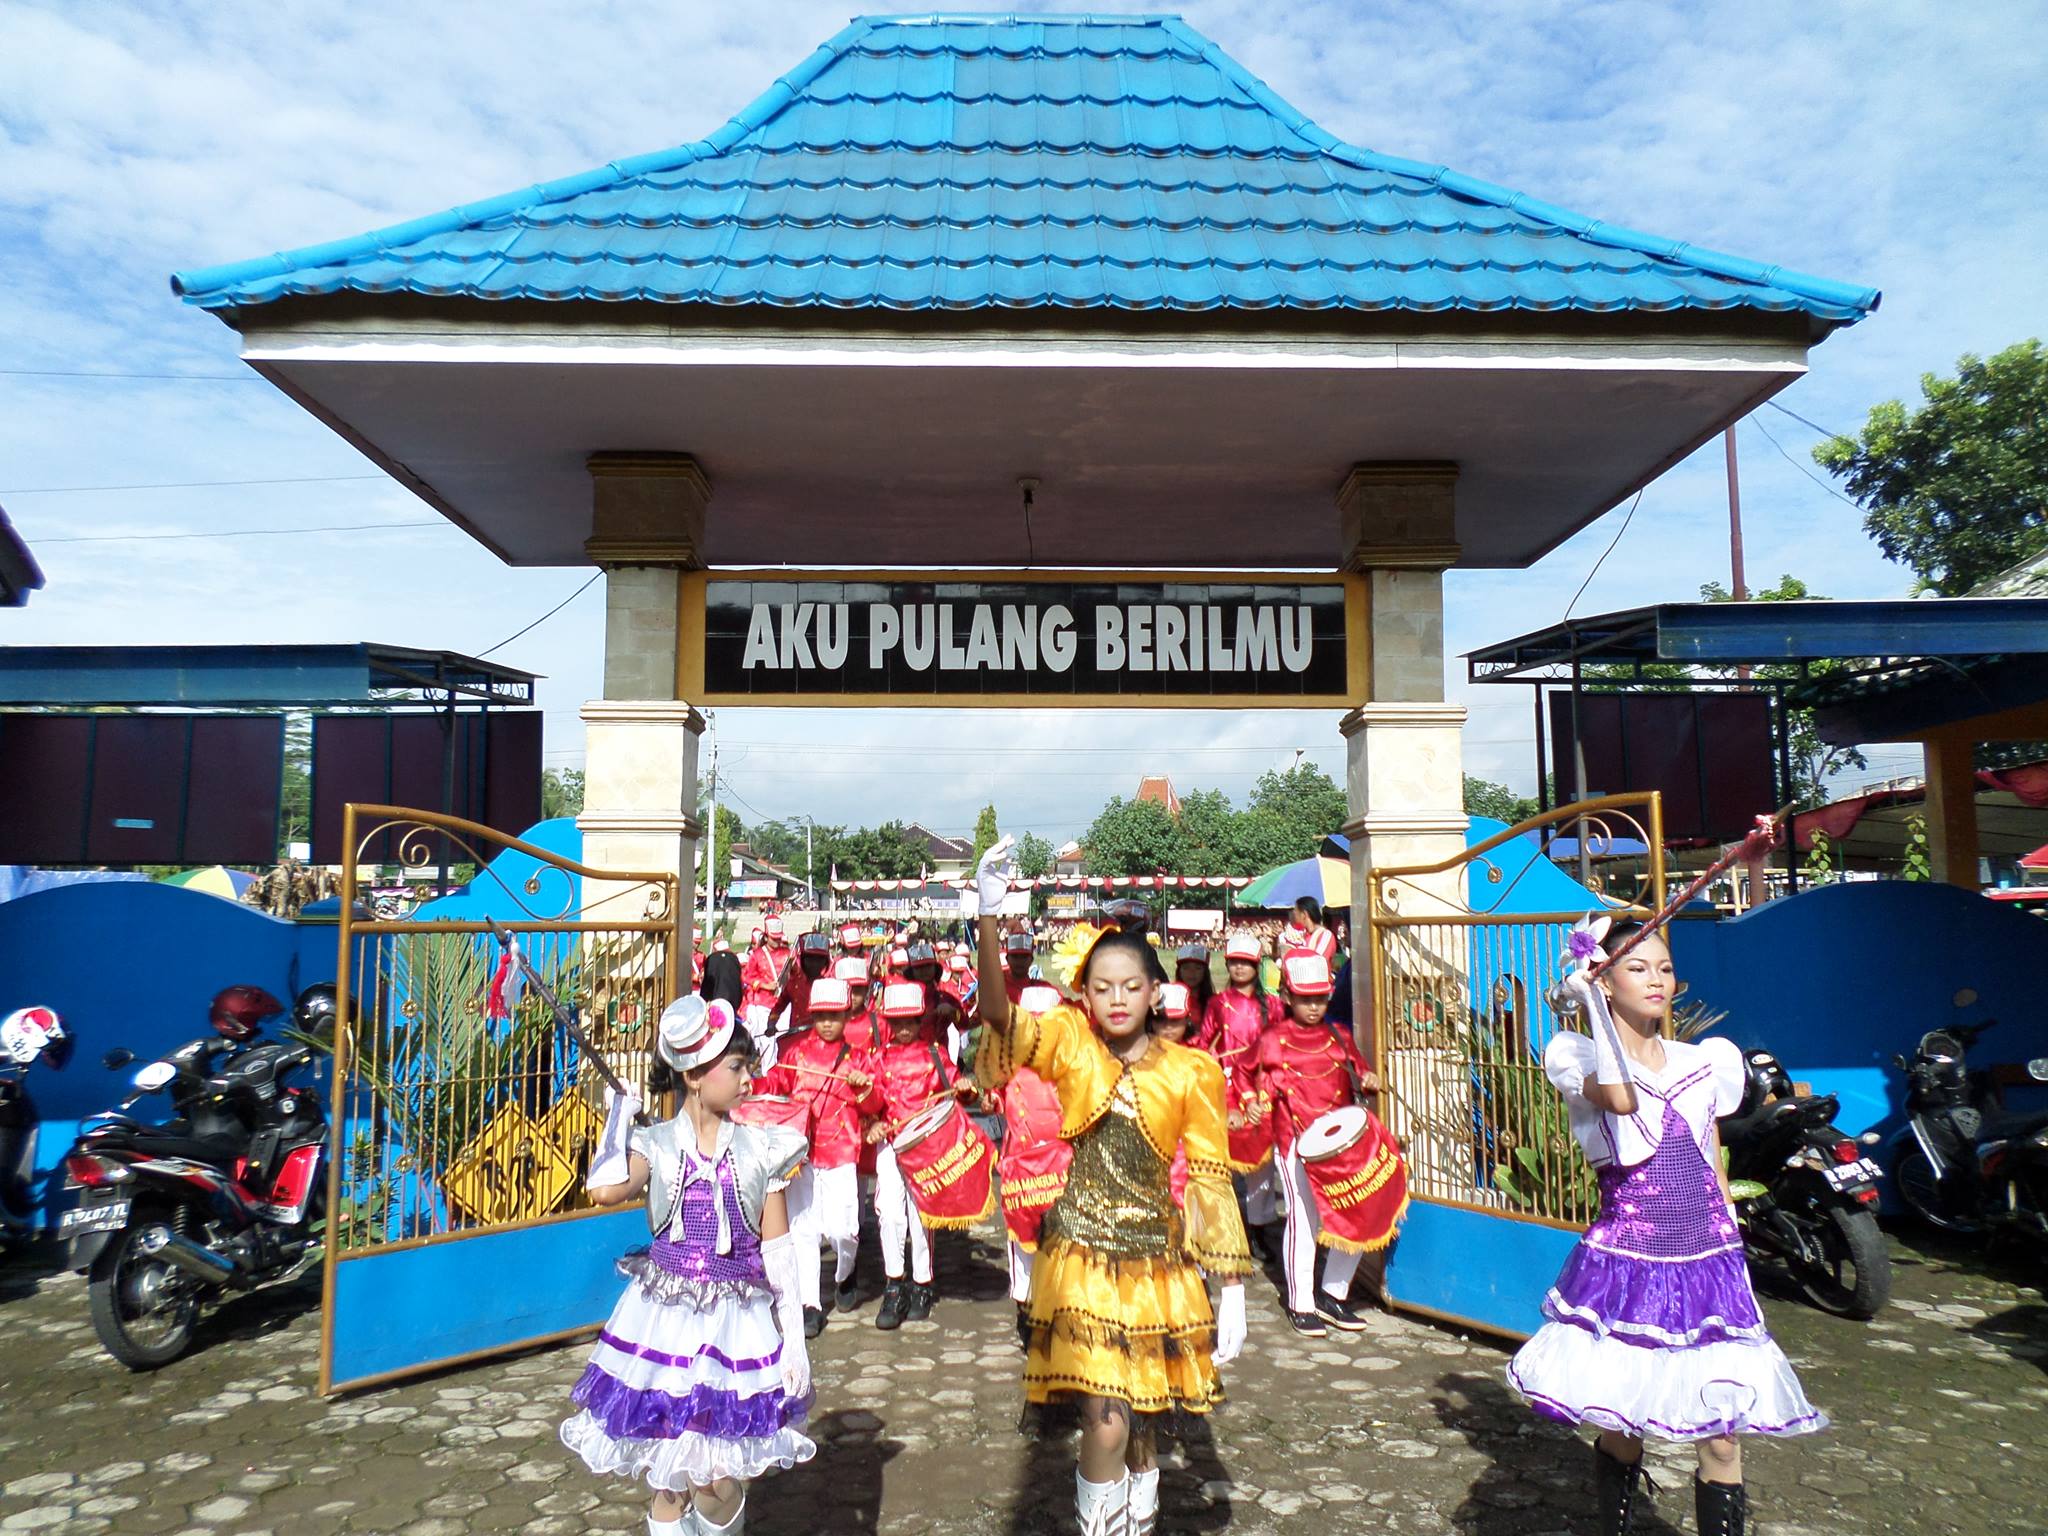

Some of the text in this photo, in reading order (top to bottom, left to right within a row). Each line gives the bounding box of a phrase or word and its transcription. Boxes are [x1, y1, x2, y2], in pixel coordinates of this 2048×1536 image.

[742, 603, 1313, 672] AKU PULANG BERILMU
